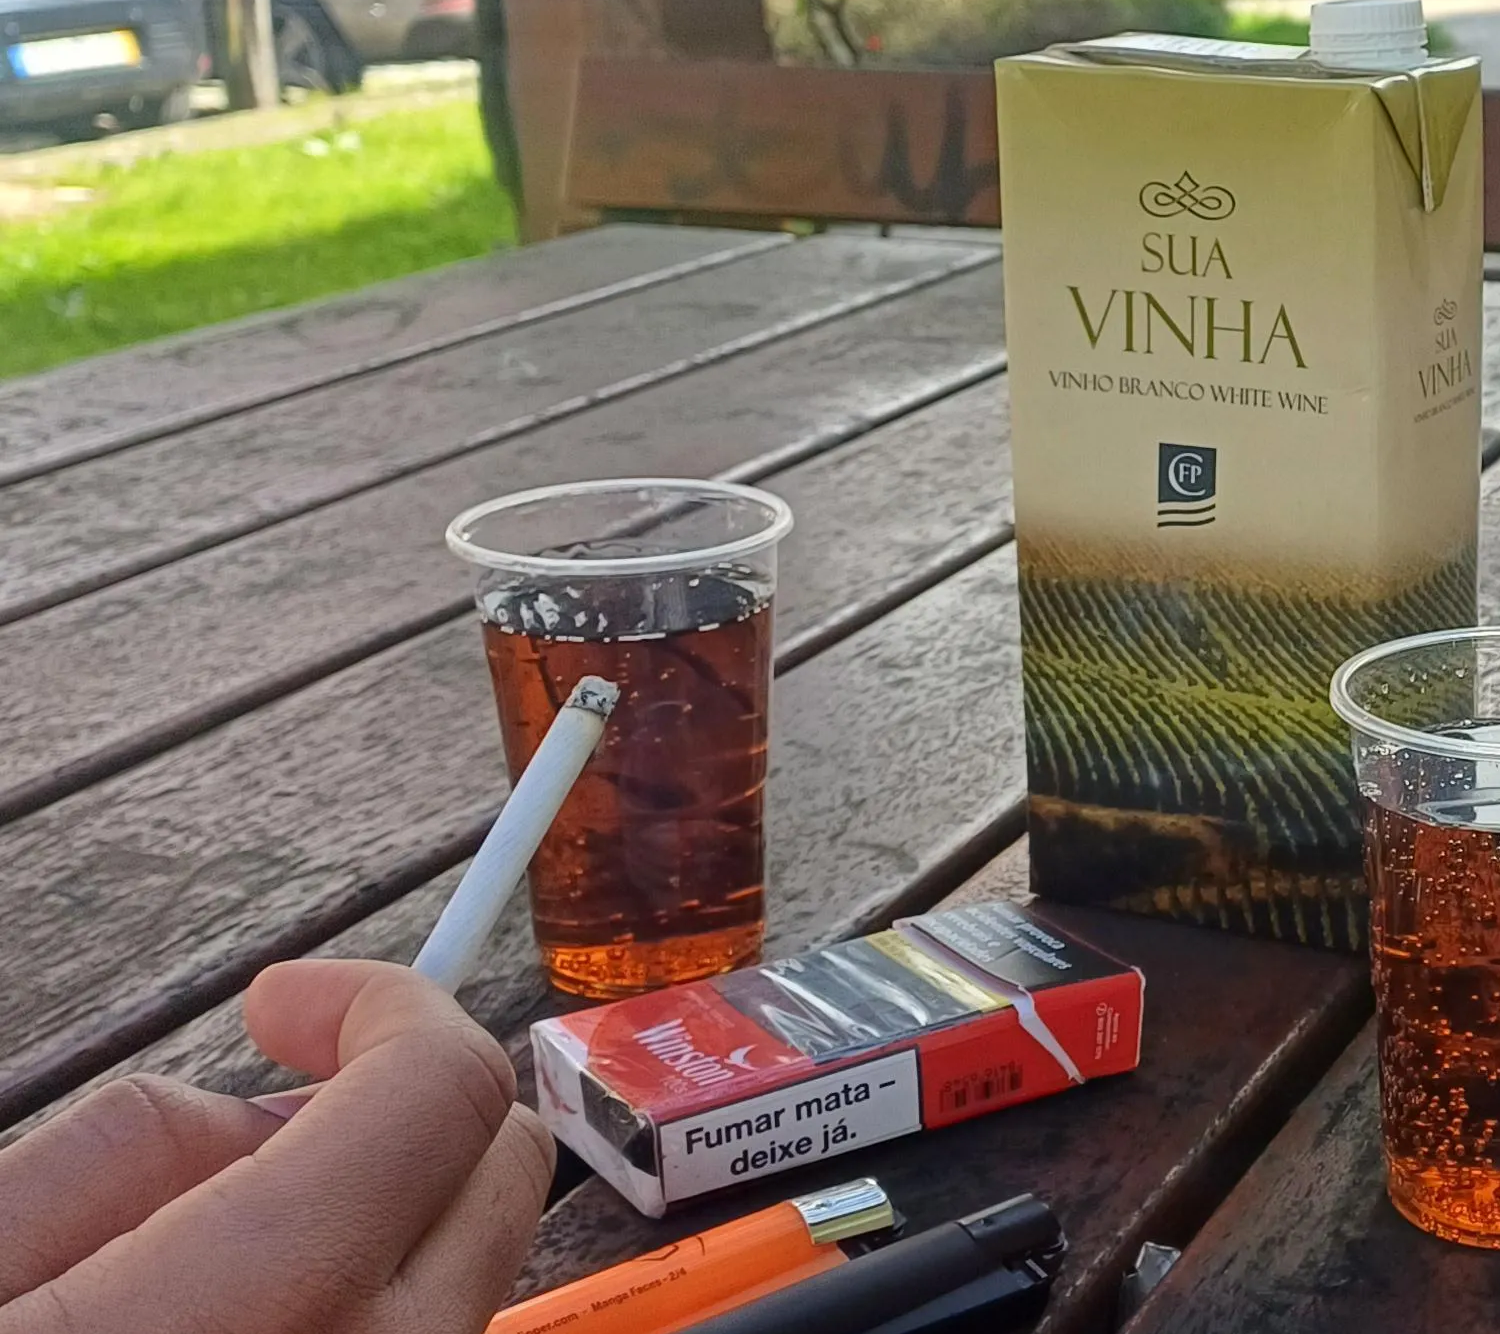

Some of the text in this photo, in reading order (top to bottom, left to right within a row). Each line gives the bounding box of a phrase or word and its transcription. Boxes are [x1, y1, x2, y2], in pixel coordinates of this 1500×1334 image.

[1141, 231, 1233, 279] SUA
[1067, 285, 1308, 369] VINHA
[1049, 370, 1329, 415] VINHO BRANCO WHITE WINE
[1418, 348, 1472, 399] VINHA
[632, 1018, 735, 1086] Winston
[685, 1108, 785, 1154] Fumar
[796, 1081, 870, 1121] mata
[730, 1117, 857, 1175] deixe já.
[591, 1291, 629, 1312] Manga
[630, 1278, 662, 1296] Faces
